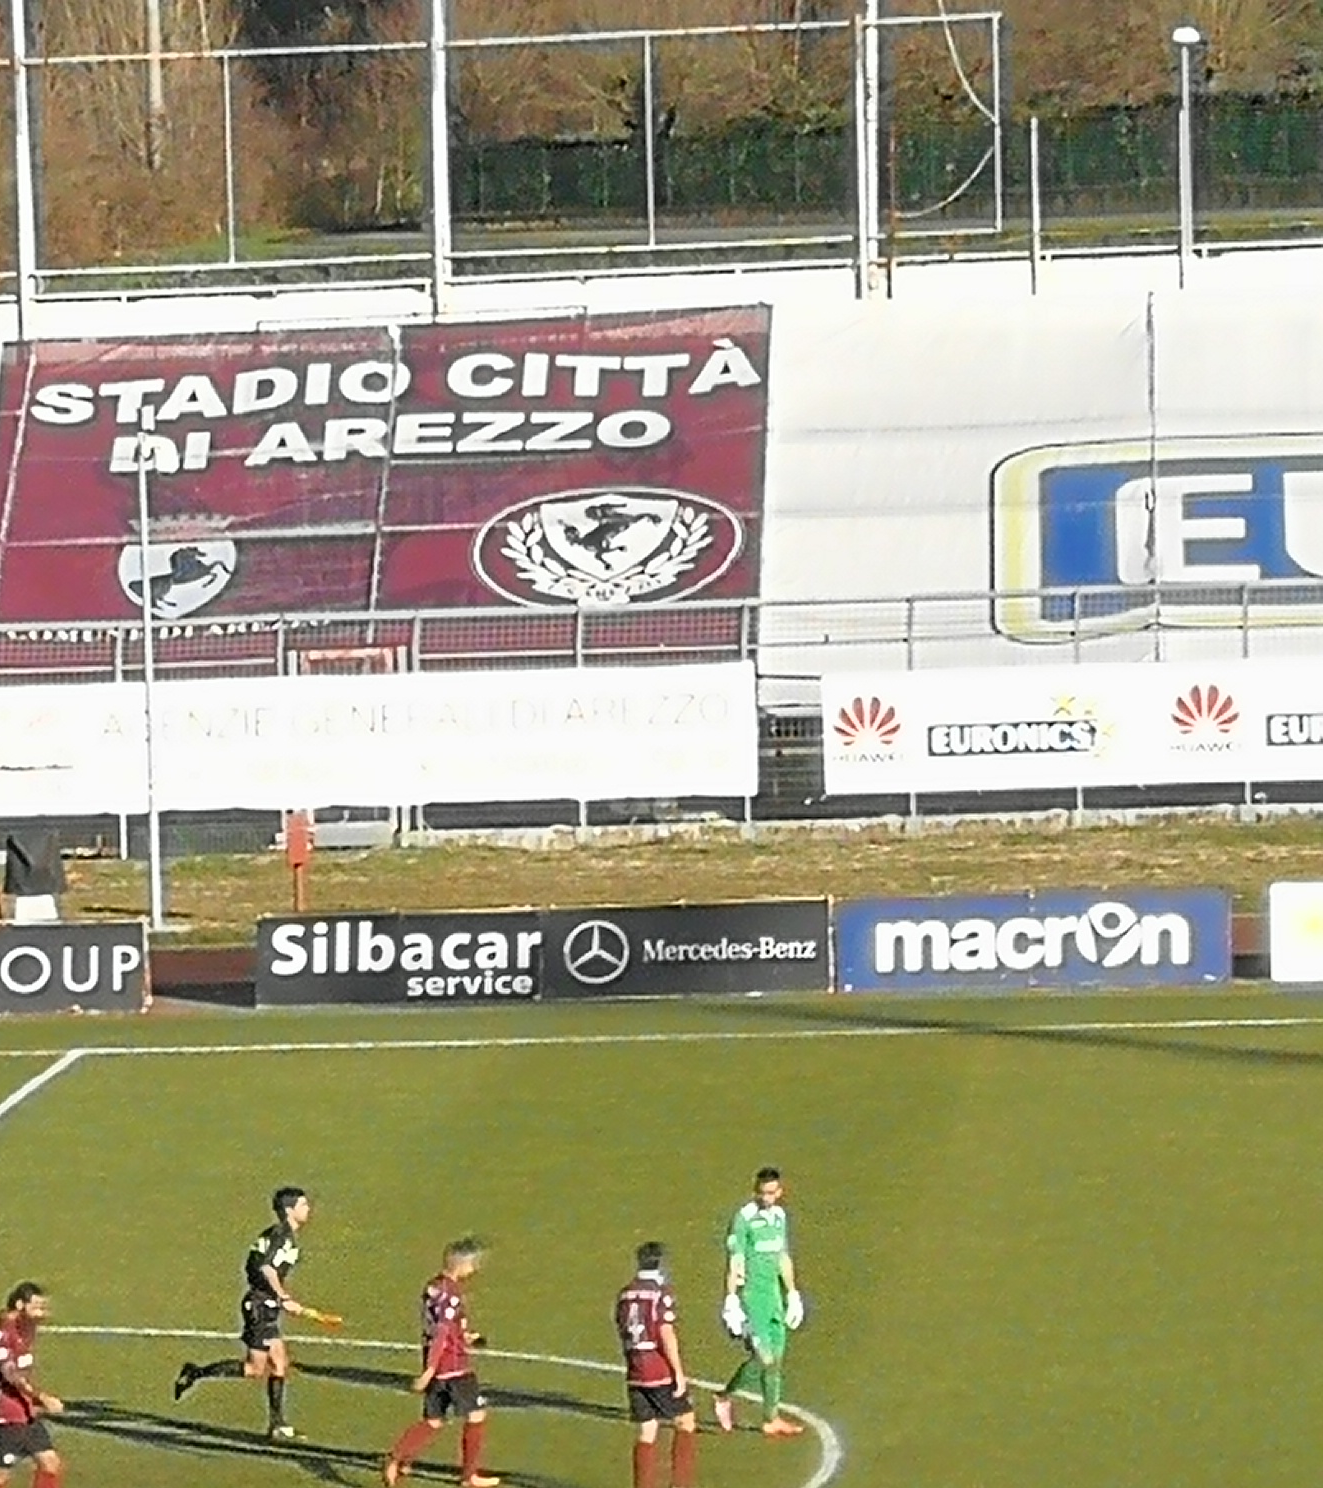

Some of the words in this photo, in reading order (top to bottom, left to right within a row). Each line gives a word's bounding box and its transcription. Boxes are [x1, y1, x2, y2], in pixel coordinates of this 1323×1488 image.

[30, 360, 410, 424] STADIO
[447, 338, 760, 397] CITTÀ
[110, 431, 210, 474] DI
[245, 409, 671, 467] AREZZO
[930, 723, 1093, 755] EURONICS
[270, 922, 543, 975] Silbacar
[643, 937, 818, 962] Mercedes-Benz
[874, 902, 1190, 973] macron
[407, 971, 533, 996] service
